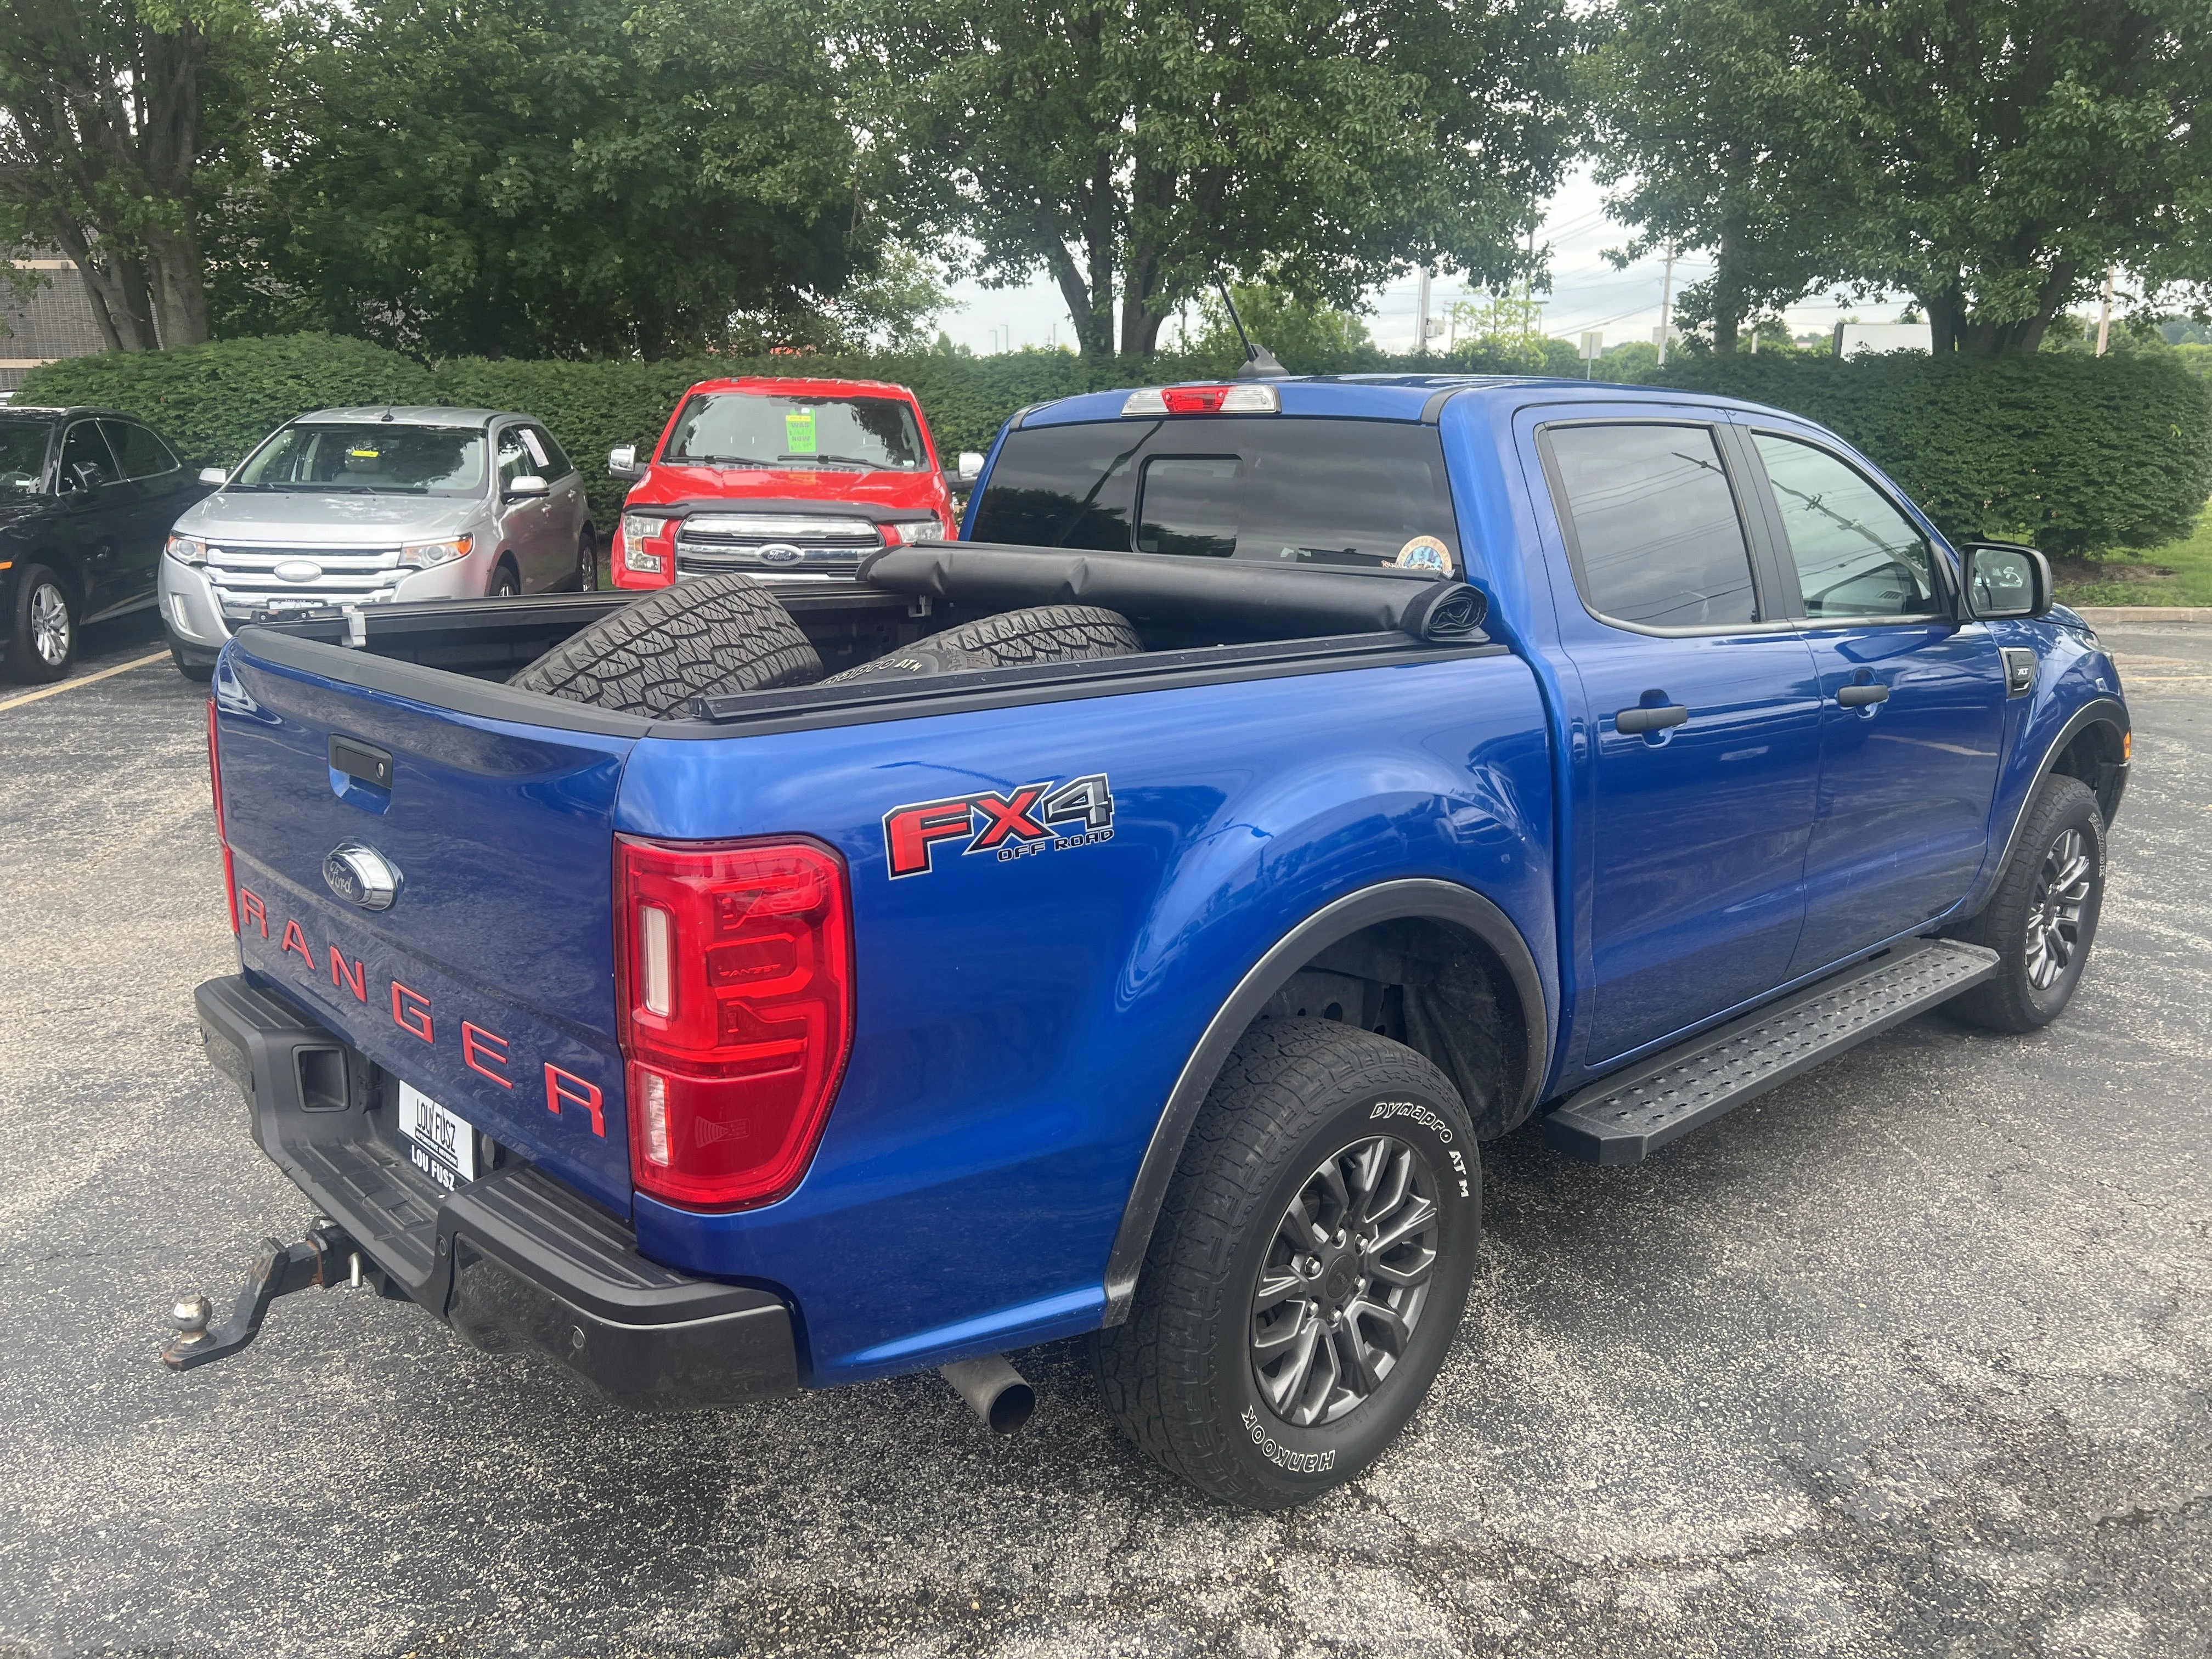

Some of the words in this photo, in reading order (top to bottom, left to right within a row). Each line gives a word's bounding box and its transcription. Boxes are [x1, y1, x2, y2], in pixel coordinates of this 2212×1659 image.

[768, 549, 791, 560] Ford
[819, 658, 895, 685] napro
[882, 772, 1114, 881] FX4
[997, 843, 1046, 862] OFF
[1054, 828, 1114, 851] ROAD
[328, 860, 353, 894] Ford
[241, 887, 606, 1138] RANGER
[417, 1098, 431, 1135] LOU
[436, 1111, 455, 1154] FUSZ
[1369, 1102, 1453, 1143] Dynapro
[416, 1130, 438, 1152] AUTOMOTIVE
[438, 1147, 457, 1166] NETWORK
[411, 1144, 428, 1172] LOU
[431, 1159, 455, 1192] FUSZ
